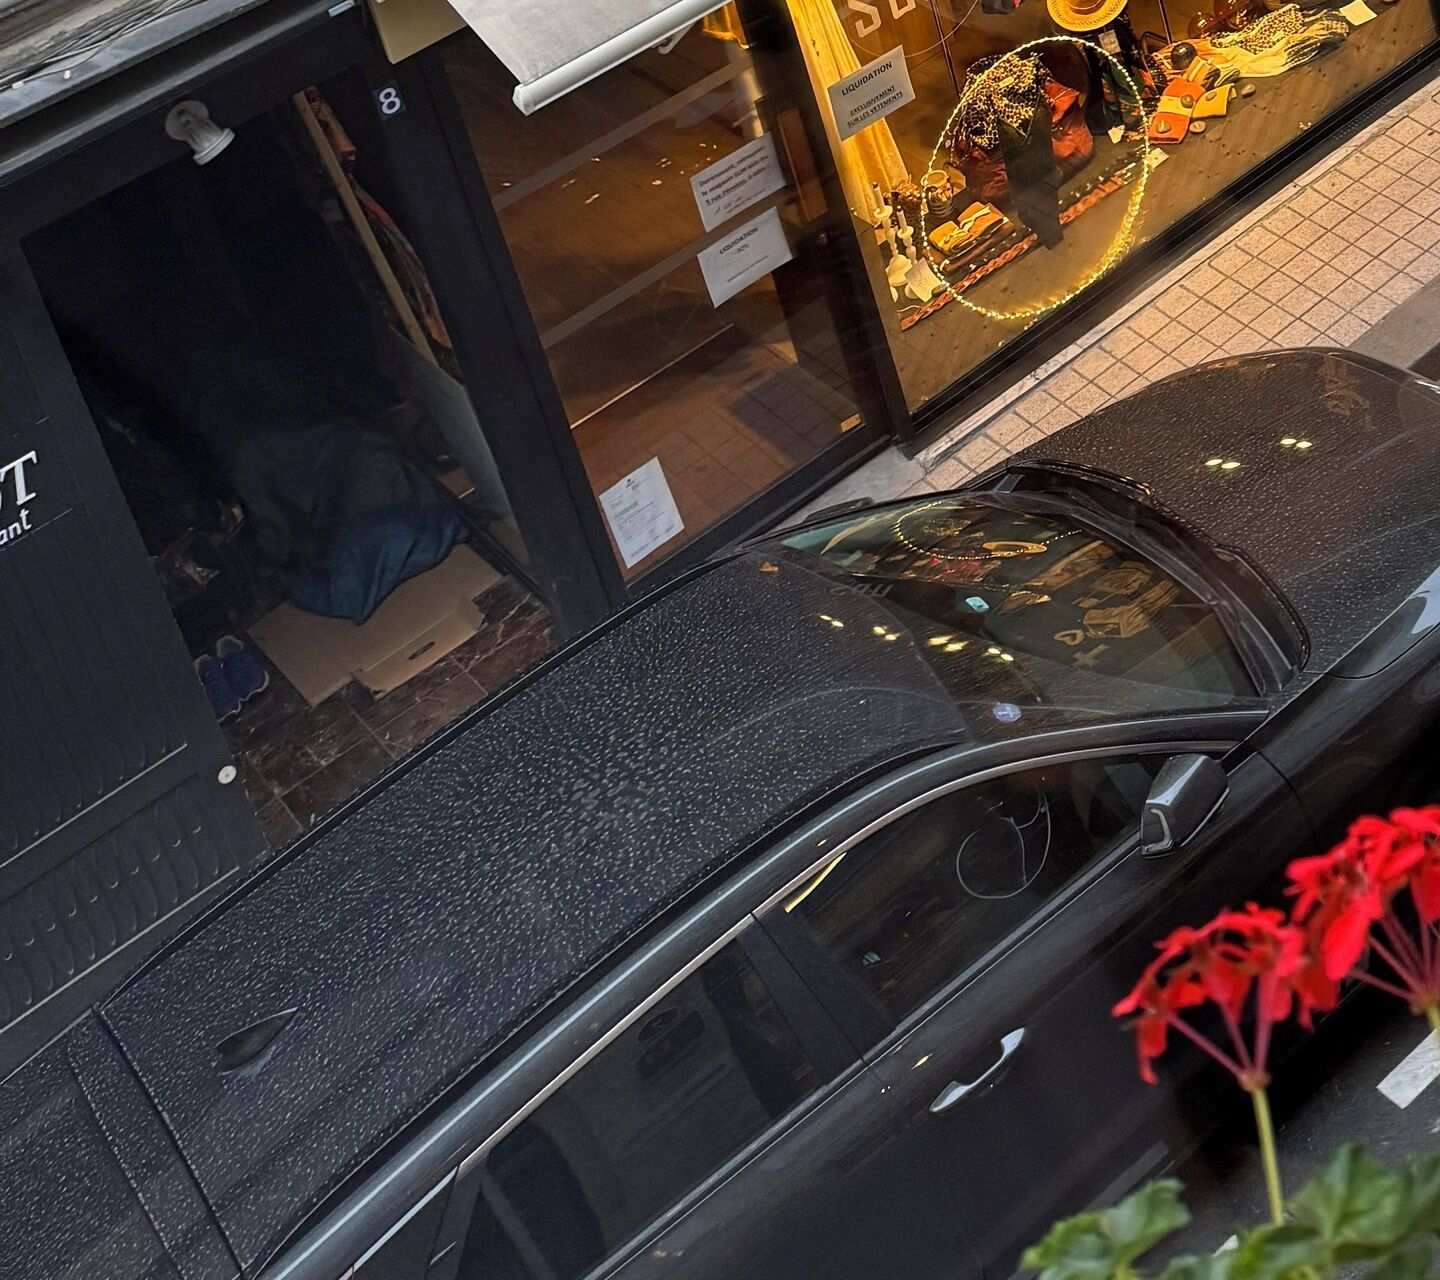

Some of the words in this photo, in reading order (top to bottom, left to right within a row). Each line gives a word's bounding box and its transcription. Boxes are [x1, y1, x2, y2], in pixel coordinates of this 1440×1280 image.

[841, 61, 893, 96] LIQUIDATION
[379, 87, 401, 114] 8
[720, 227, 758, 255] LIQUIDATION
[0, 450, 37, 509] T
